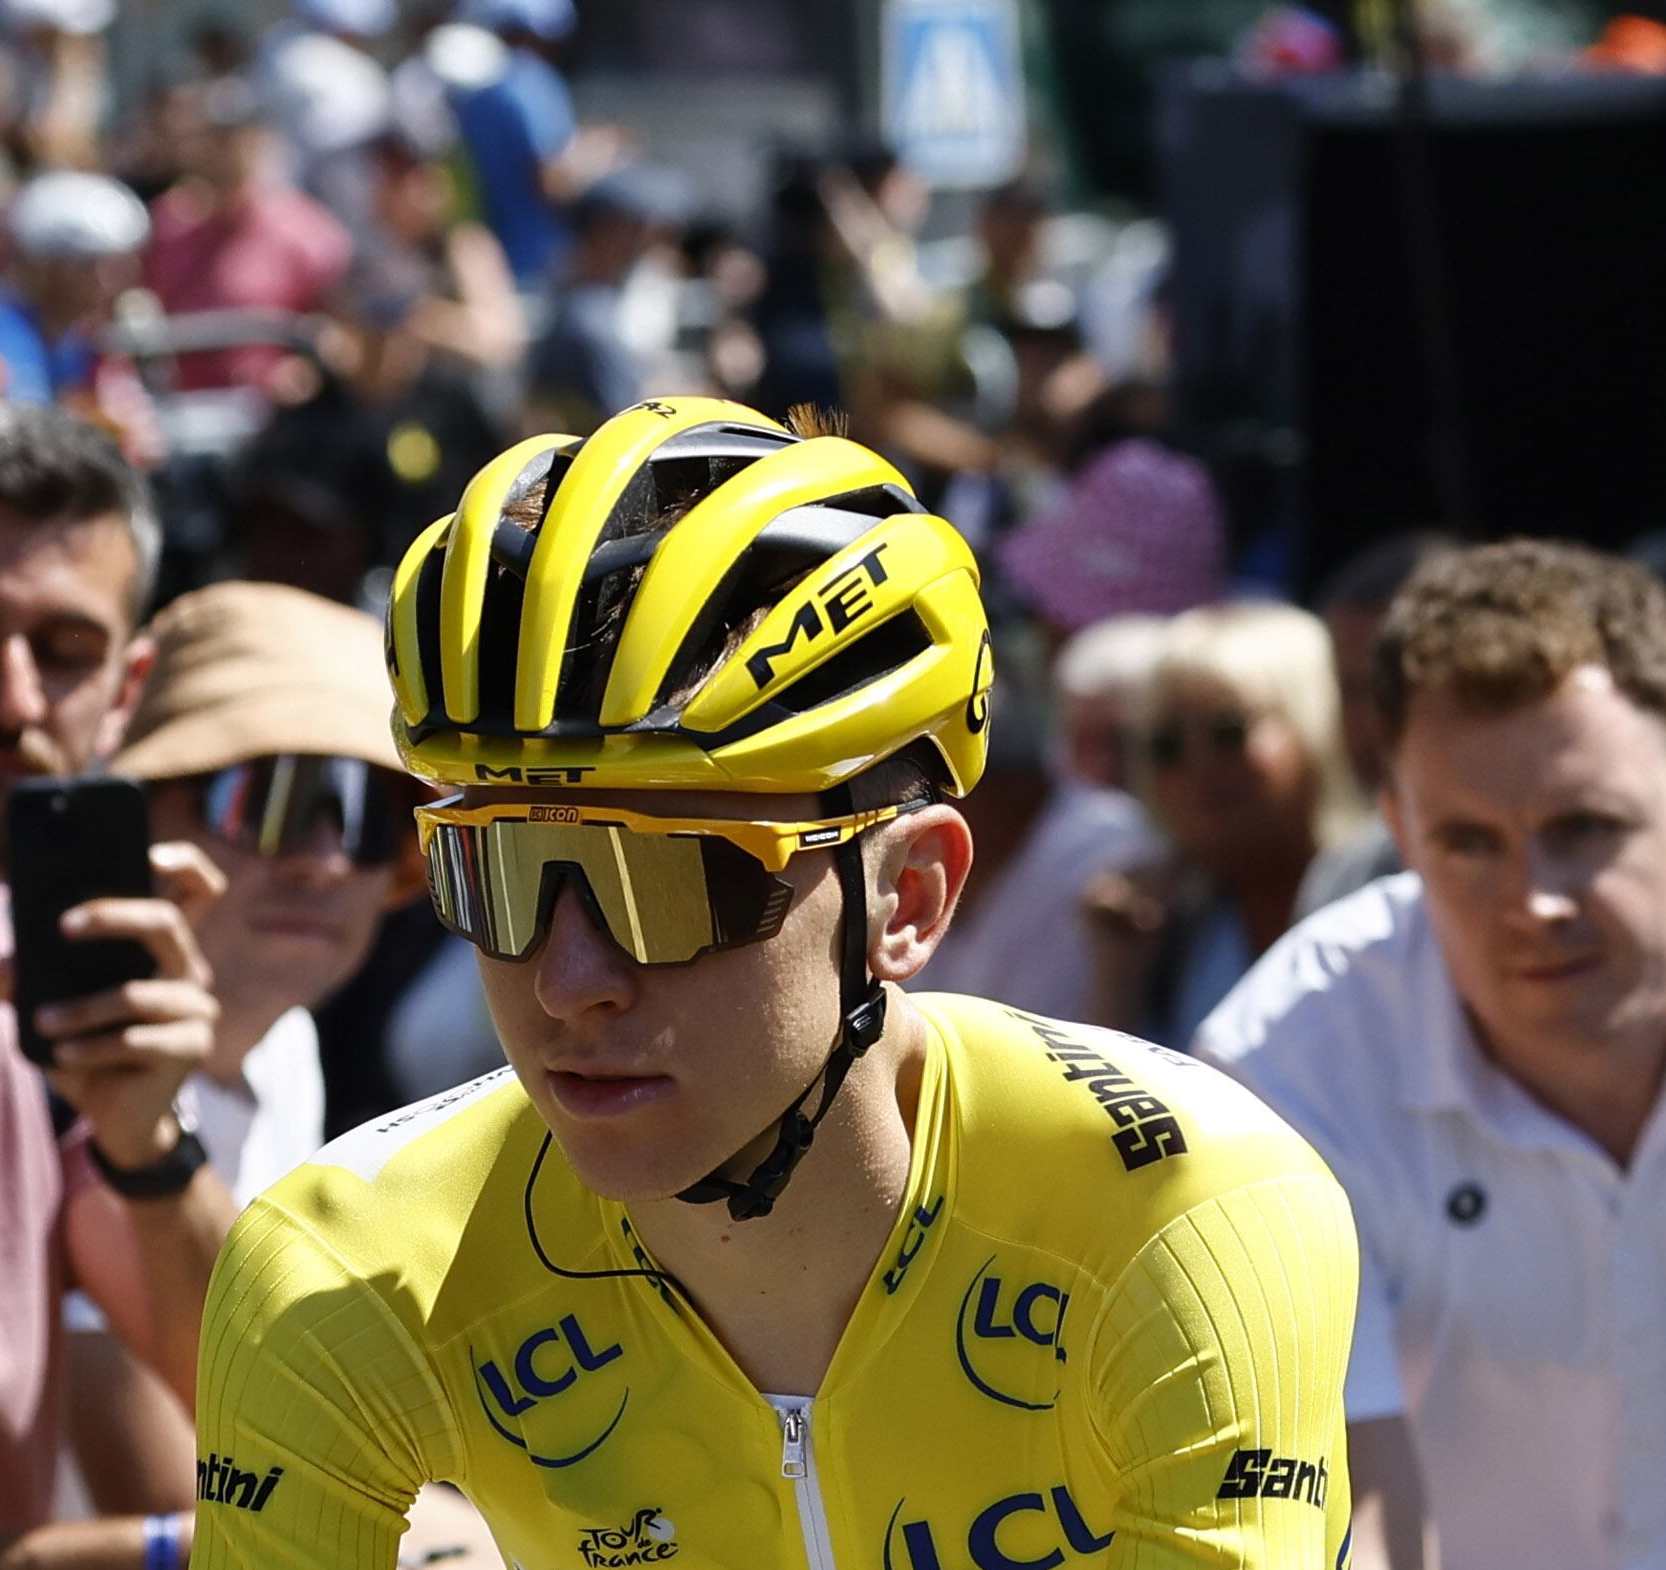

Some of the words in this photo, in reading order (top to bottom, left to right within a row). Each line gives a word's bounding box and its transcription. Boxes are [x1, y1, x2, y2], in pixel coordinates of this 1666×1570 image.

[745, 543, 888, 690] MET
[474, 764, 596, 785] MET
[479, 1314, 623, 1416] LCL
[196, 1454, 285, 1512] ntini
